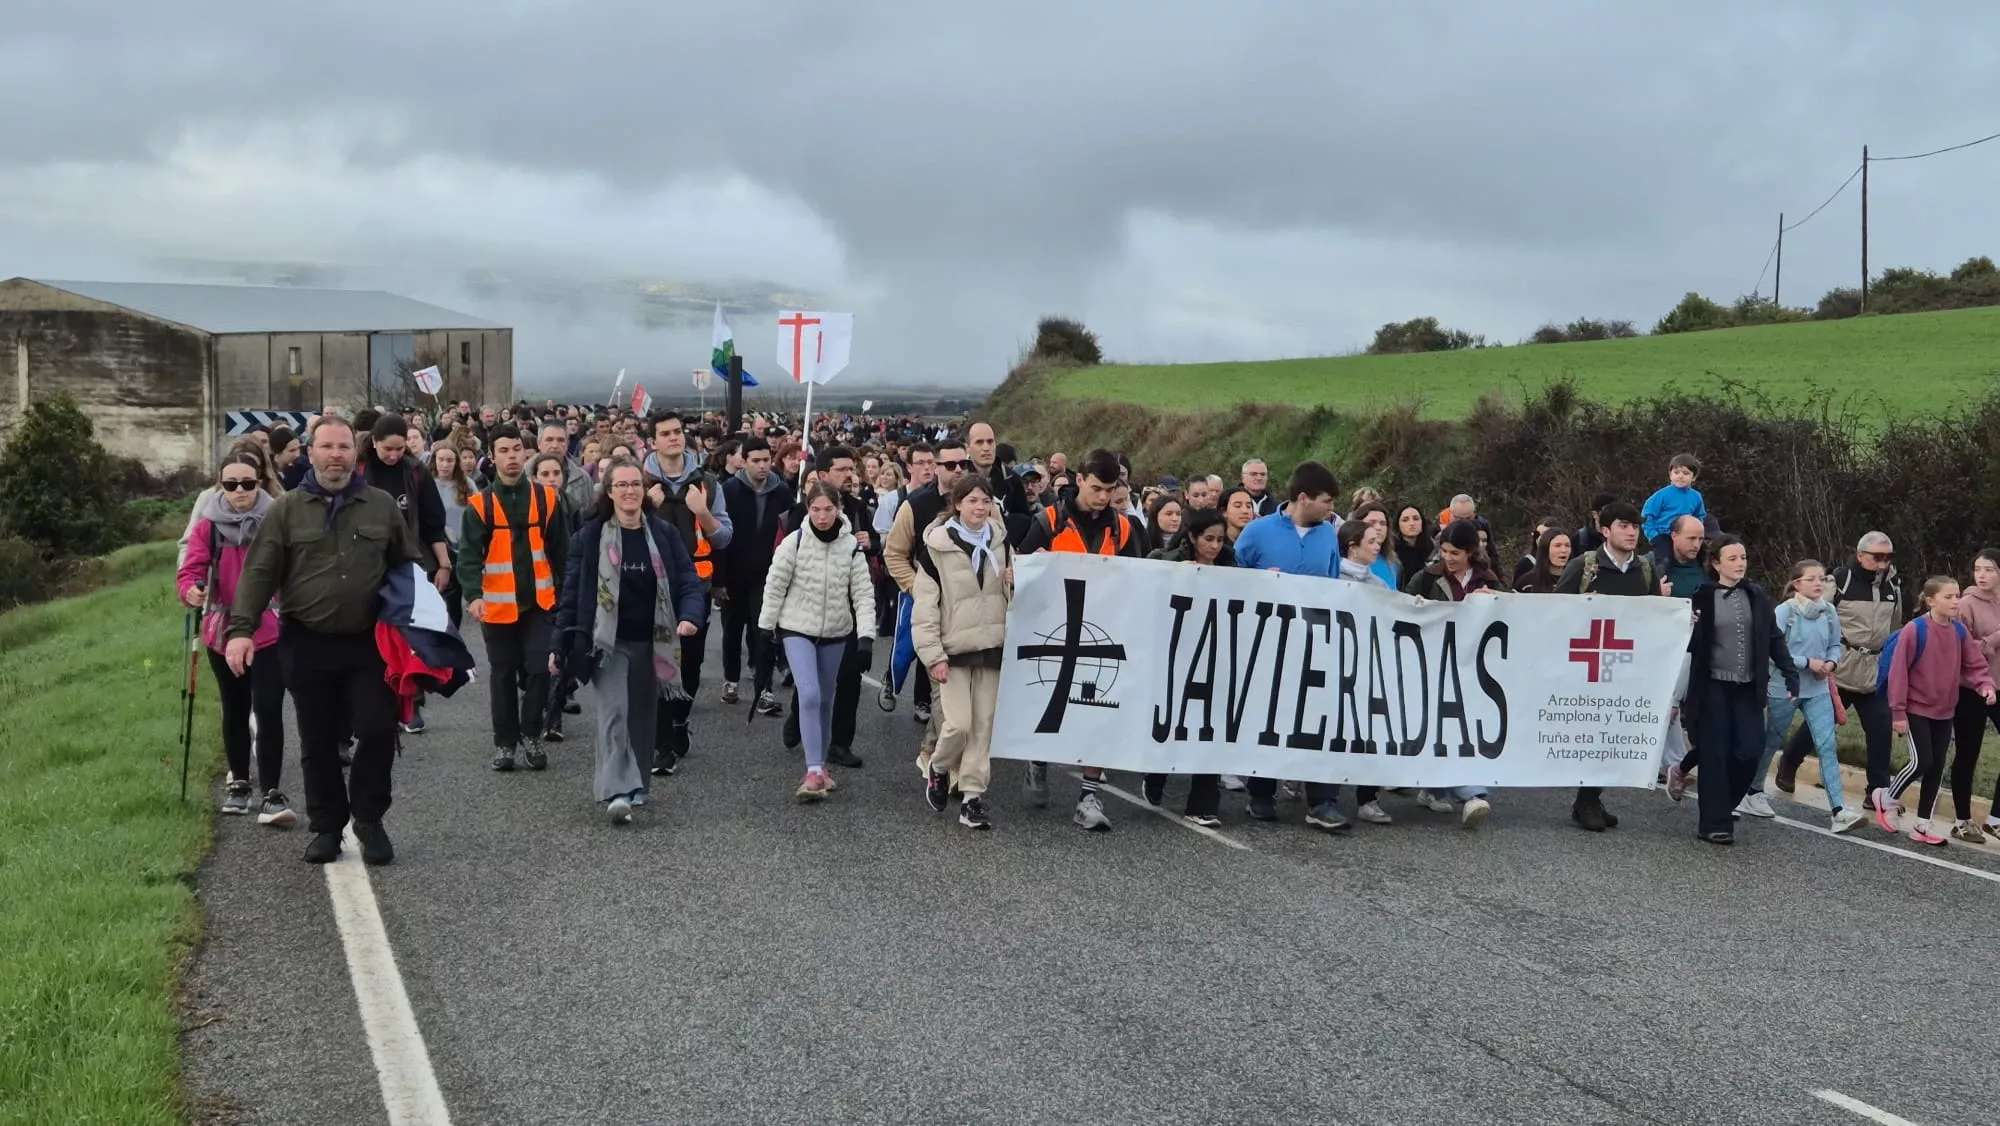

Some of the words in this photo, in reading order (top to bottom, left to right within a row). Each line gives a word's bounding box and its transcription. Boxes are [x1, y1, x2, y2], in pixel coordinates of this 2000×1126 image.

[1152, 594, 1509, 759] JAVIERADAS
[1547, 693, 1631, 709] Arzobispado
[1634, 695, 1651, 709] de
[1538, 708, 1601, 725] Pamplona
[1604, 713, 1613, 726] y
[1616, 710, 1659, 724] Tudela
[1538, 730, 1570, 744] Iruña
[1574, 733, 1594, 744] eta
[1598, 731, 1657, 746] Tuterako
[1546, 747, 1648, 762] Artzapezpikutza
